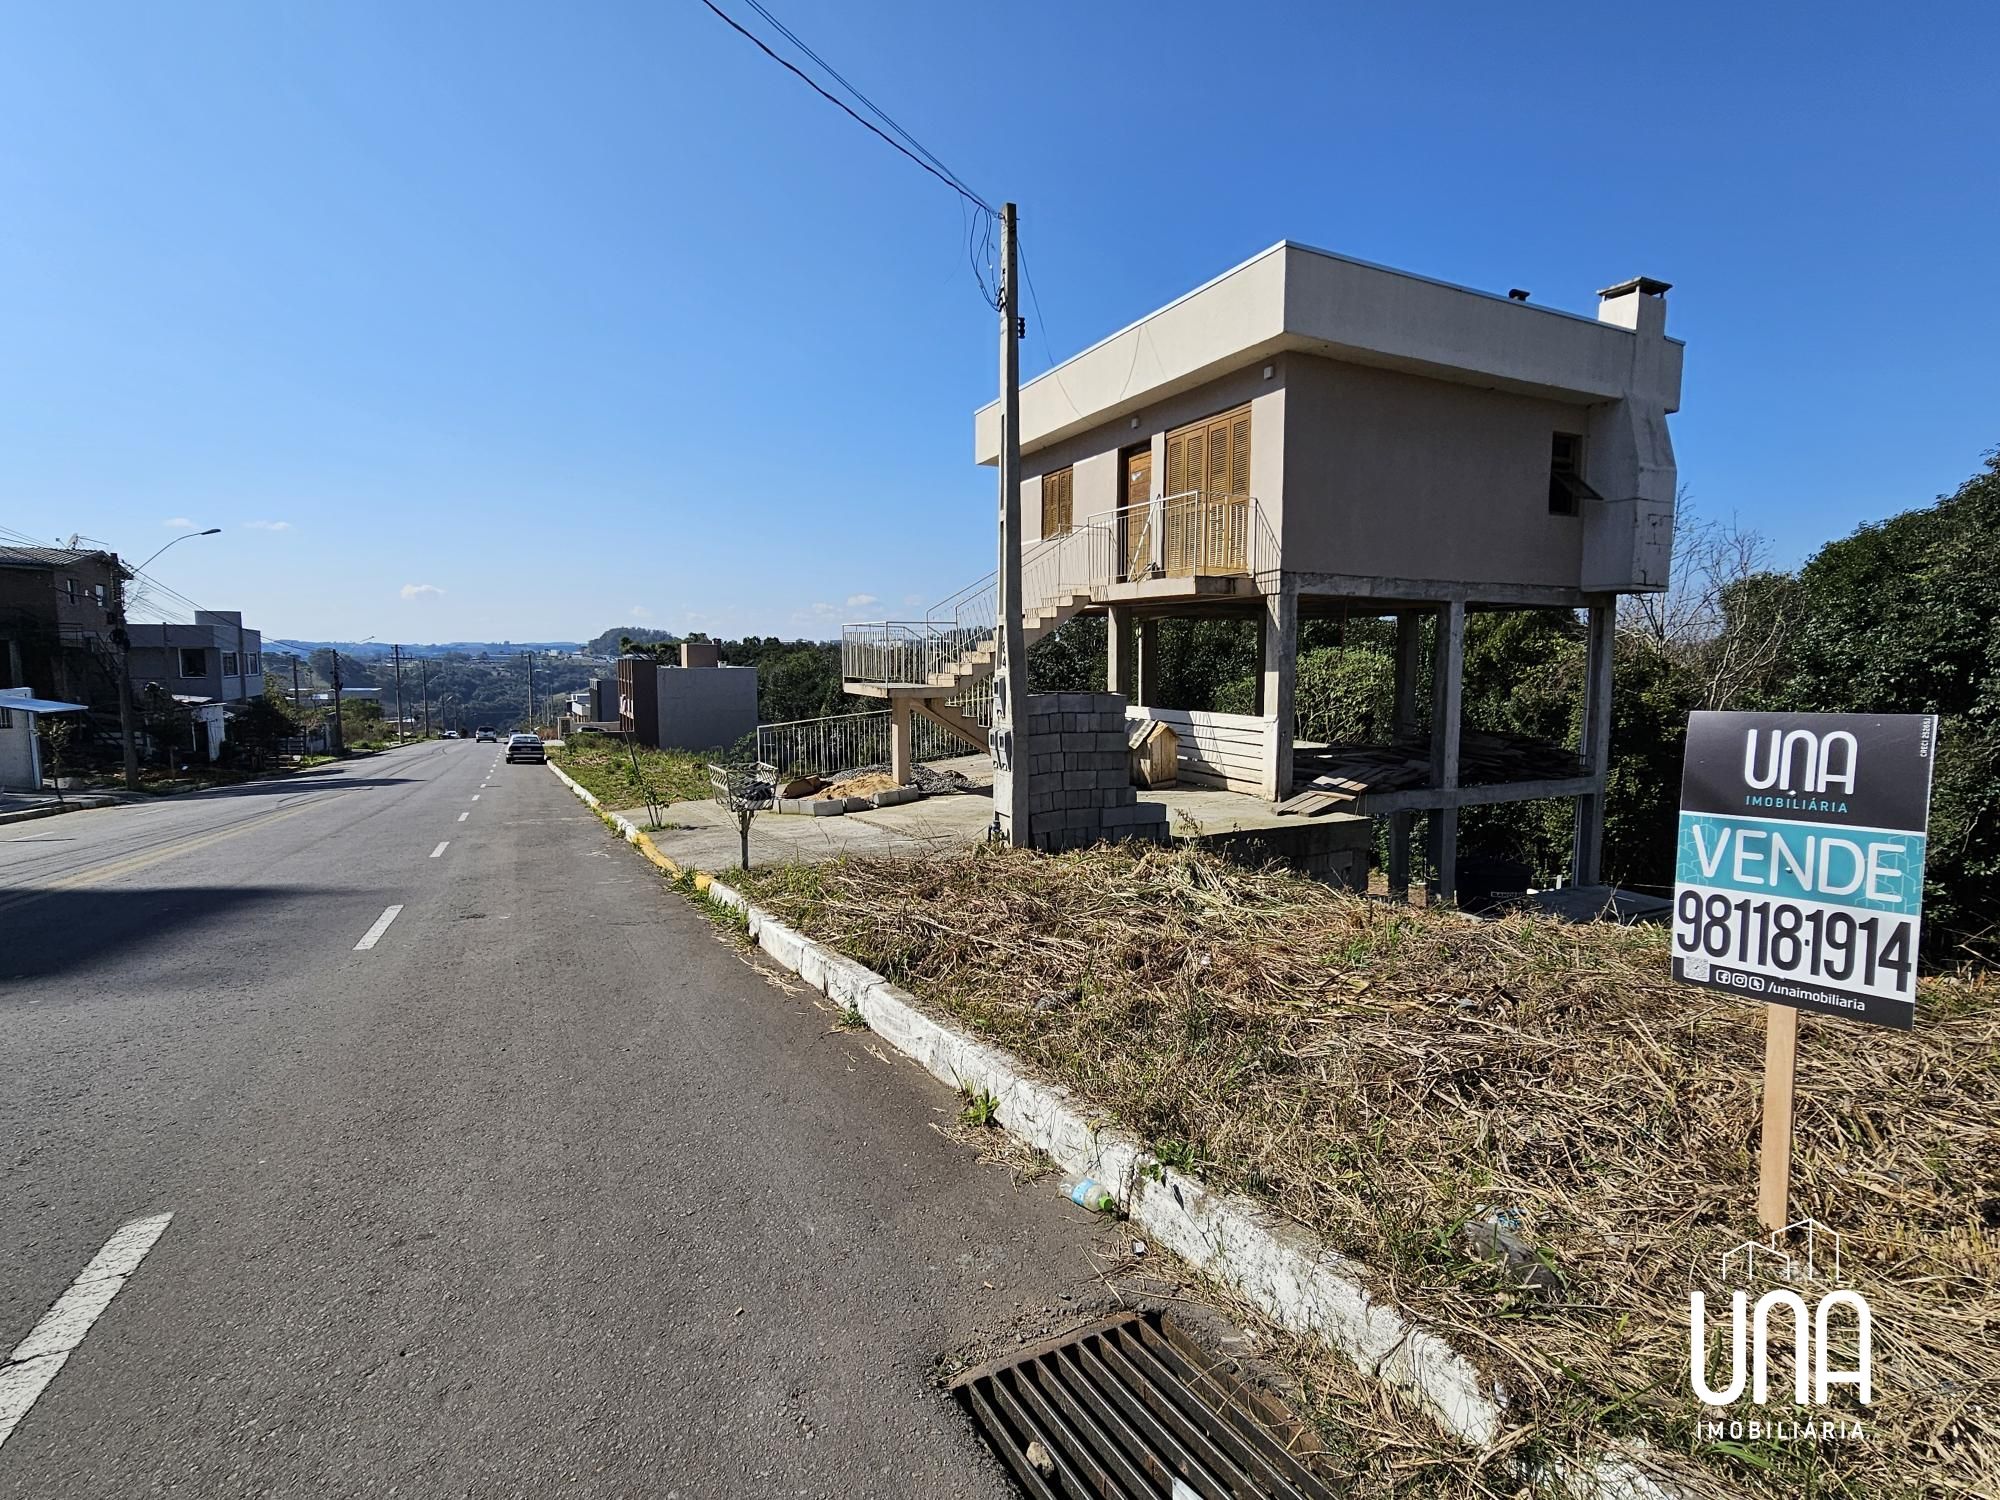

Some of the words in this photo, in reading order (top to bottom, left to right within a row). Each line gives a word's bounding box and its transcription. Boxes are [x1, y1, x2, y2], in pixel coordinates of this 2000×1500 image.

[1744, 729, 1858, 795] UNA
[1745, 796, 1848, 813] IMOBILIÁRIA
[1693, 824, 1906, 902] VENDE
[1768, 981, 1865, 1011] /unaimobiliaria
